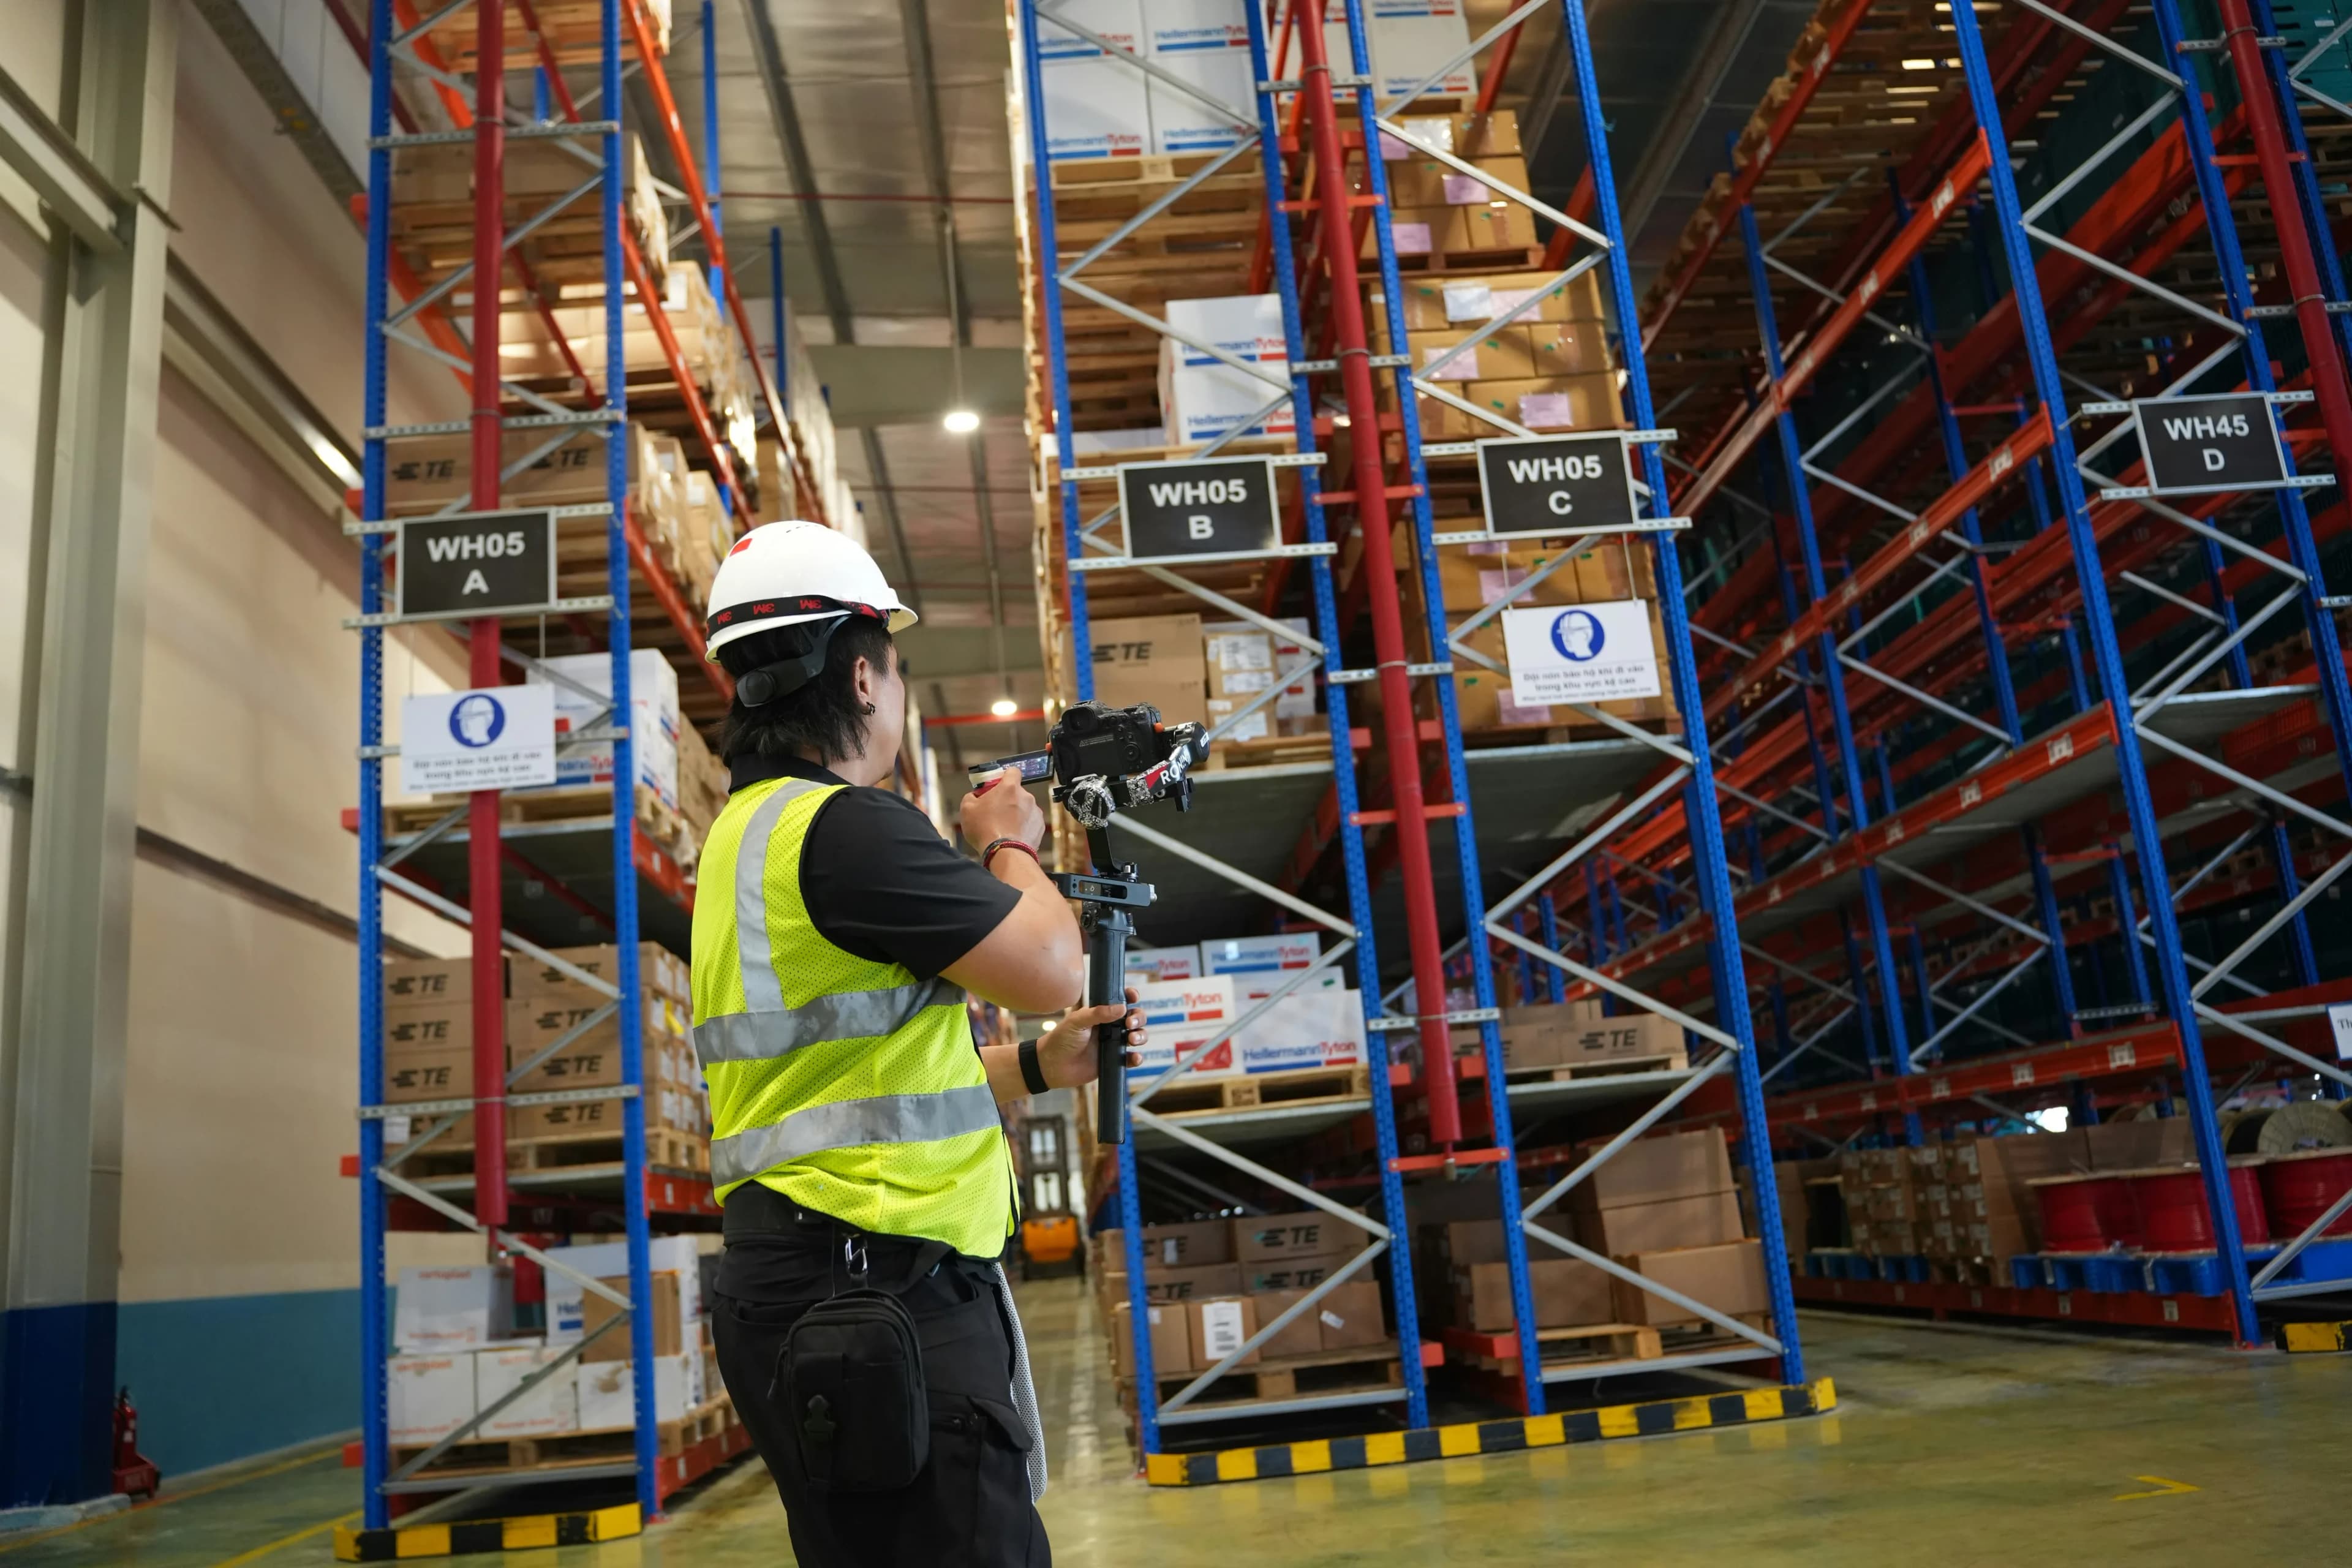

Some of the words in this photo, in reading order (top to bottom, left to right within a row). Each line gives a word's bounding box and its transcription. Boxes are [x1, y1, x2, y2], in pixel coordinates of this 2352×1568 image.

[2163, 414, 2249, 441] WH45
[560, 448, 589, 467] TE
[2202, 448, 2226, 472] D
[426, 460, 455, 479] TE
[1507, 455, 1604, 484] WH05
[1149, 479, 1248, 508] WH05
[1548, 491, 1573, 515] C
[1188, 515, 1214, 540] B
[426, 531, 526, 562] WH05
[462, 569, 489, 595] A
[1120, 641, 1153, 660] TE
[419, 974, 448, 992] TE
[421, 1020, 450, 1039] TE
[1609, 1029, 1638, 1048] TE
[1243, 1042, 1357, 1061] HellermannTyton
[573, 1055, 602, 1073] TE
[423, 1066, 451, 1085] TE
[575, 1102, 604, 1121] TE
[1290, 1225, 1320, 1245] TE
